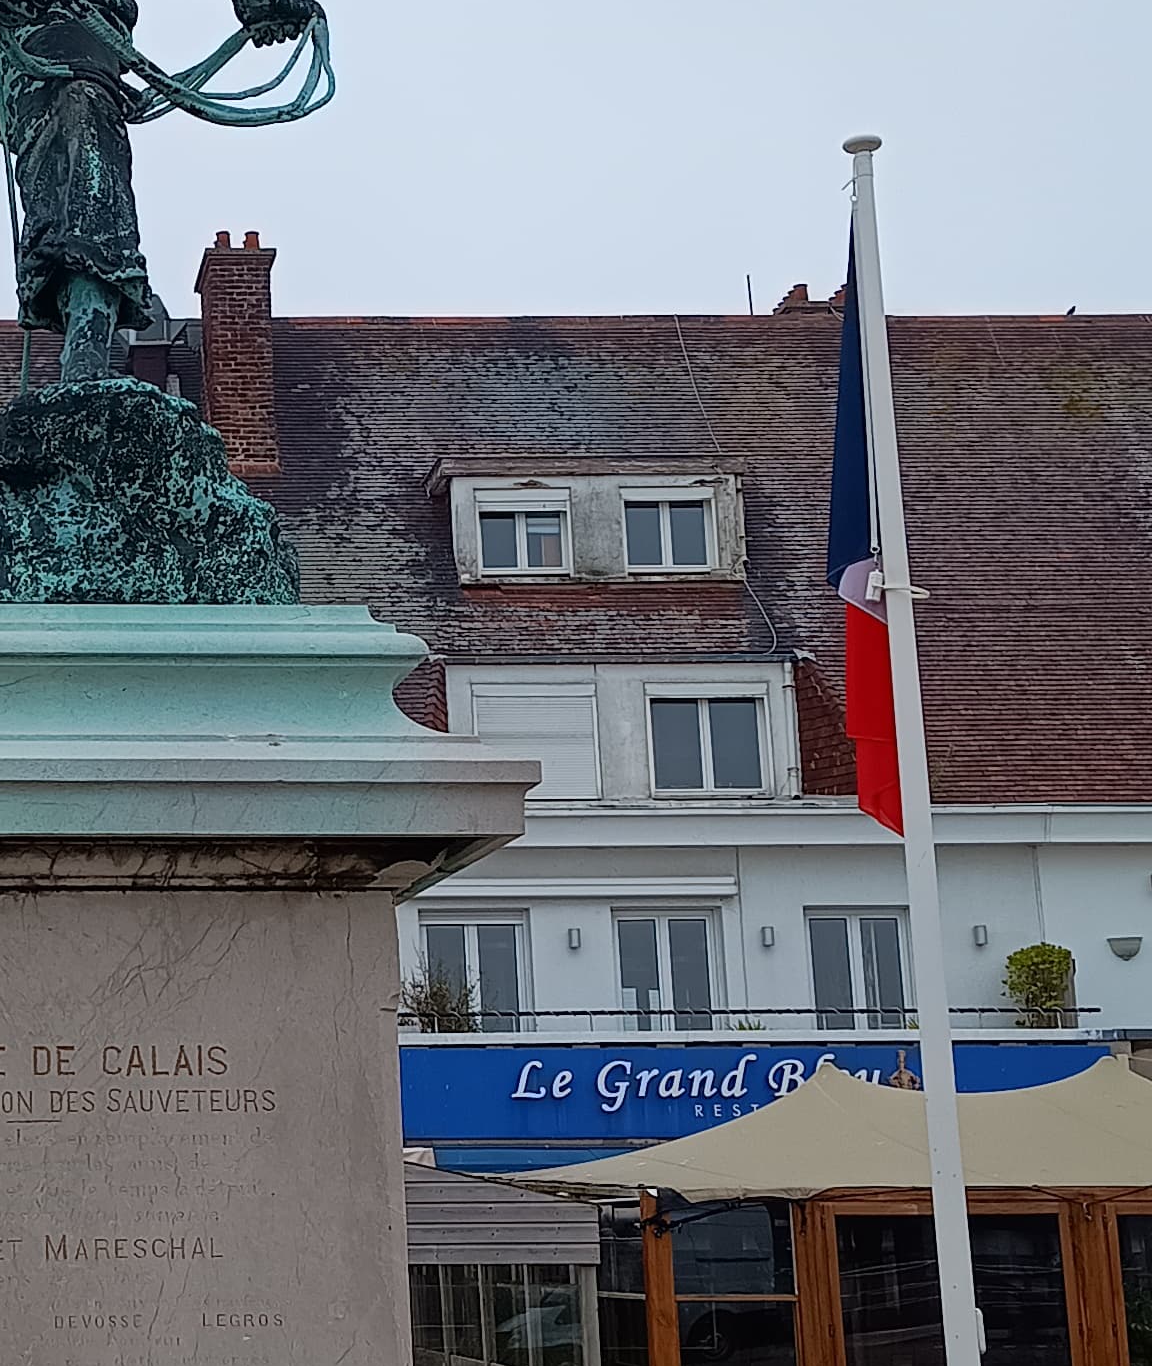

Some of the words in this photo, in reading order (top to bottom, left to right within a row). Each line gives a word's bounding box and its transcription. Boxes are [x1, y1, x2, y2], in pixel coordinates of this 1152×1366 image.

[33, 1046, 76, 1077] DE
[102, 1045, 228, 1077] CALAIS
[511, 1060, 573, 1100] Le
[596, 1053, 757, 1112] Grand
[50, 1090, 96, 1114] DES
[106, 1088, 277, 1114] SAUVETEURS
[45, 1234, 224, 1261] MARESCHAL
[54, 1313, 144, 1330] DEVOSSE
[201, 1312, 285, 1328] LEGROS
